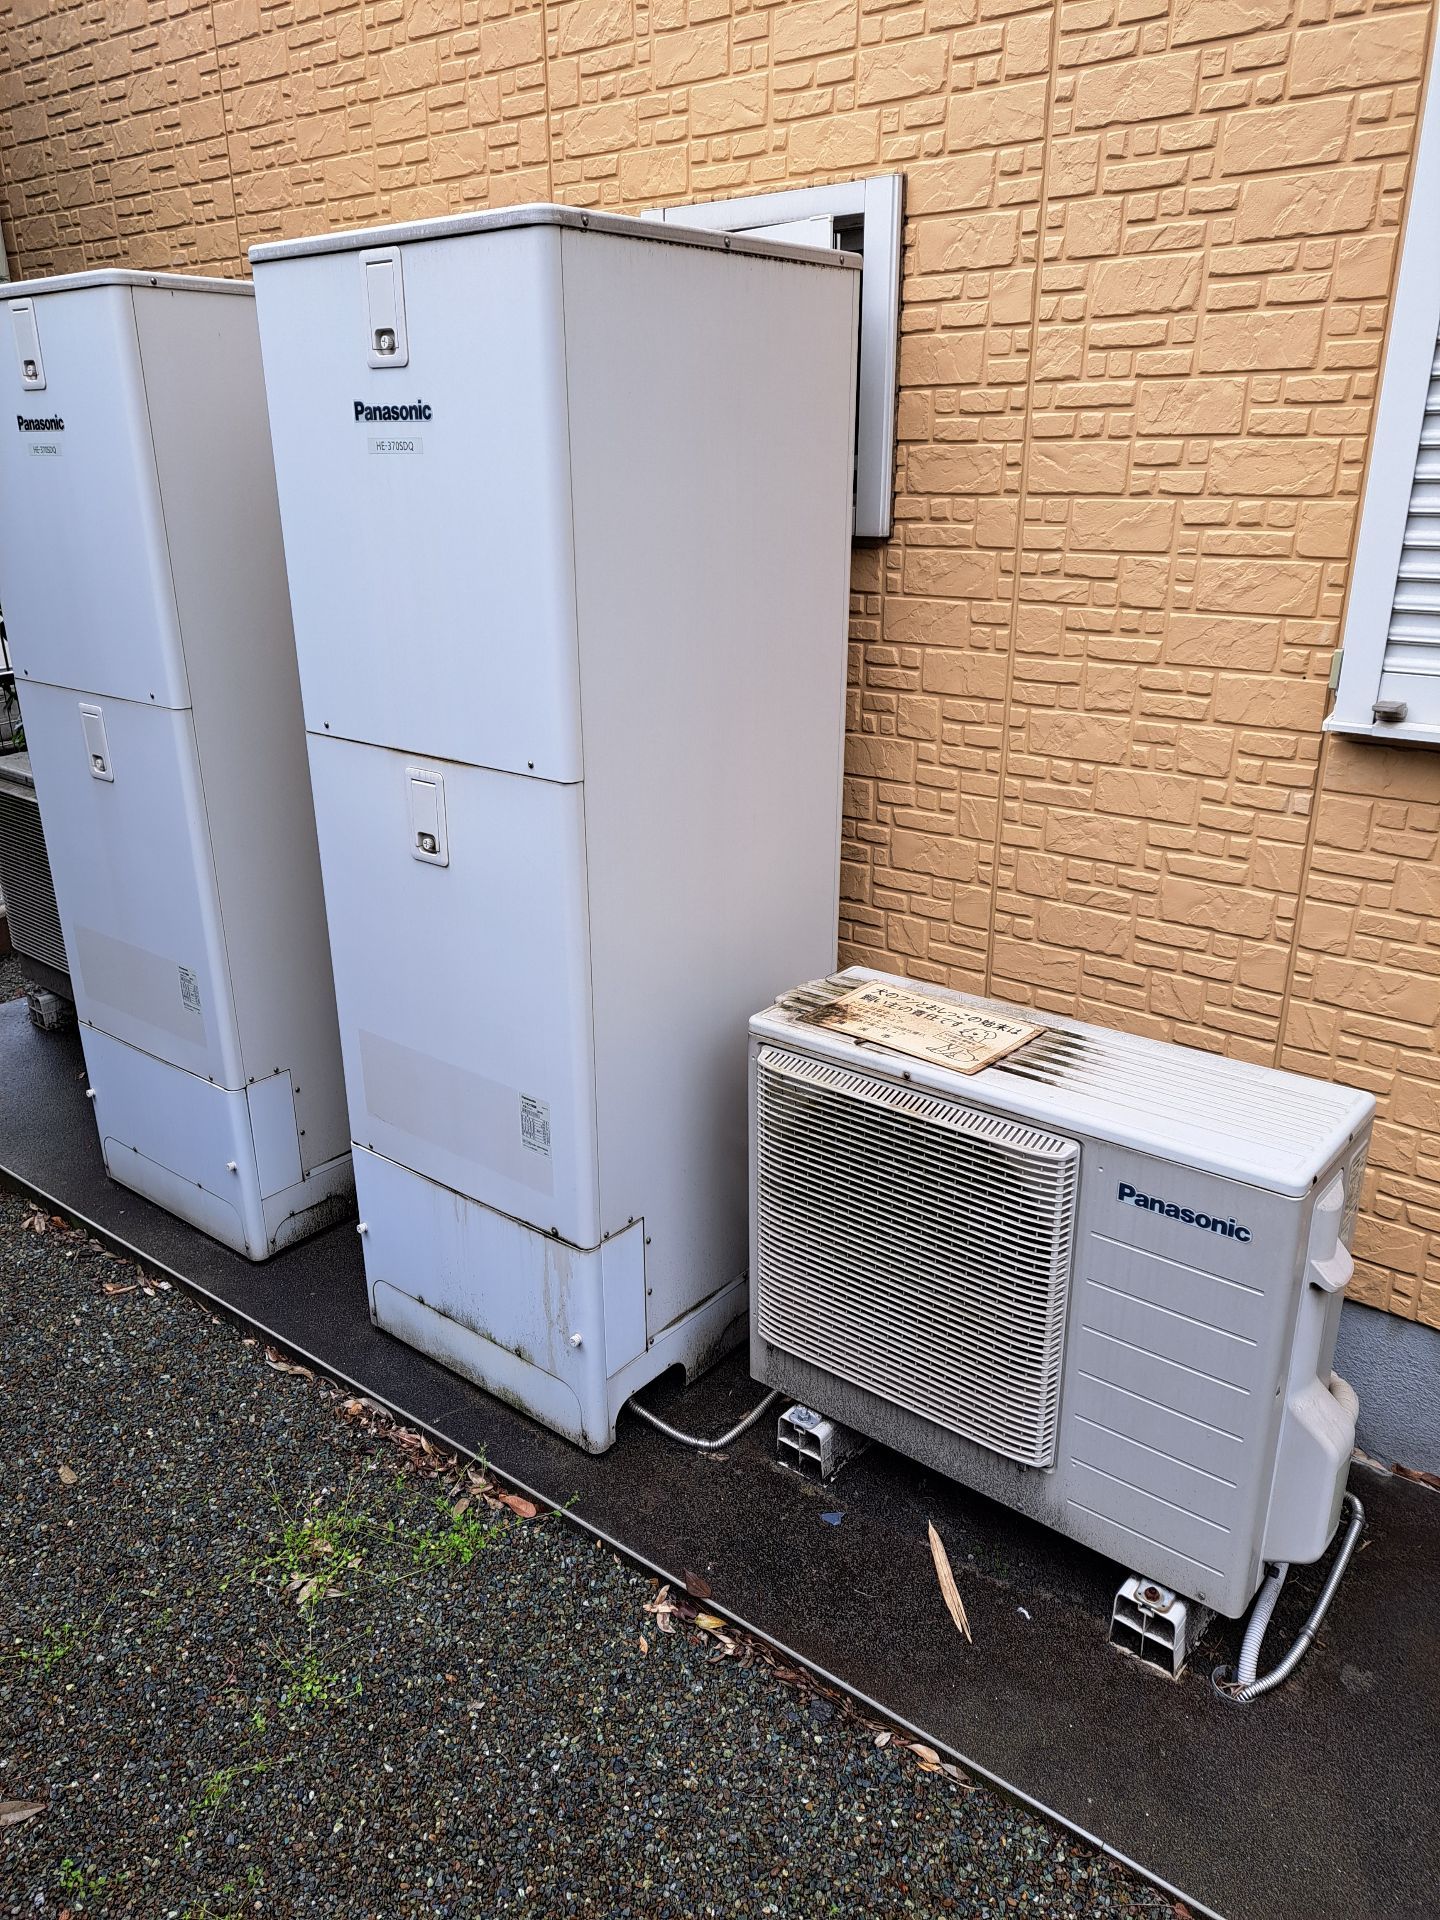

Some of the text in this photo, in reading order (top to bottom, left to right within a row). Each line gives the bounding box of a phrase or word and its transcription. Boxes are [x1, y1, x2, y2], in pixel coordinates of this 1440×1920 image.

[17, 414, 64, 431] Panasonic
[354, 399, 431, 420] Panasonic
[376, 441, 414, 451] HE-370SDQ
[859, 994, 963, 1027] 飼い主の責任です
[871, 988, 1022, 1035] 犬のフンとおしっこの始末は
[1118, 1182, 1251, 1242] Panasonic
